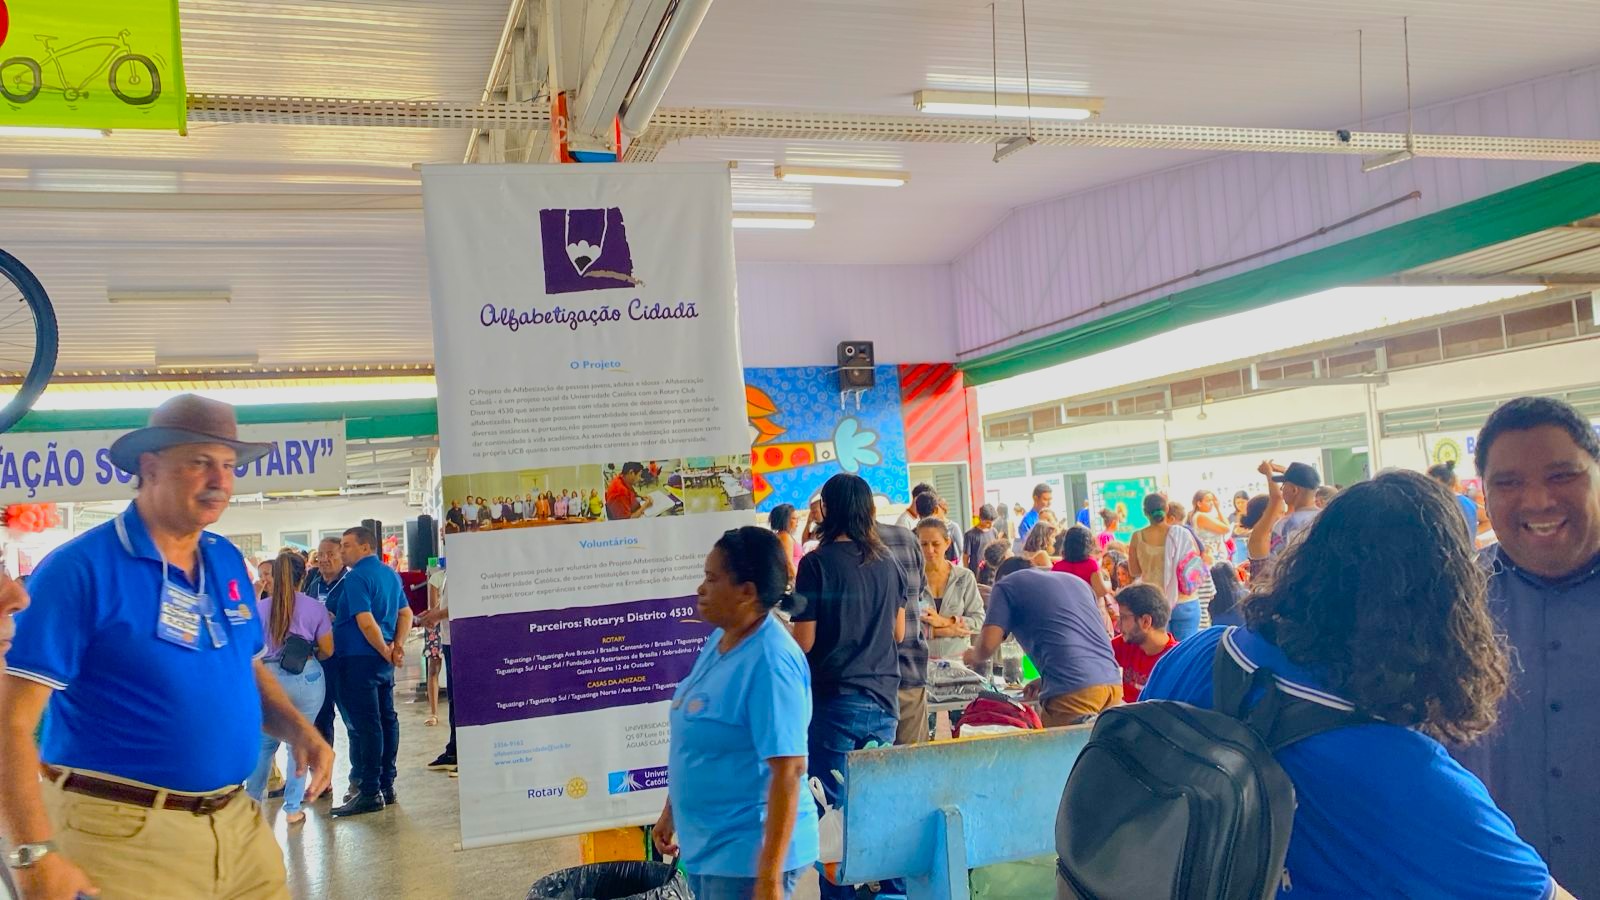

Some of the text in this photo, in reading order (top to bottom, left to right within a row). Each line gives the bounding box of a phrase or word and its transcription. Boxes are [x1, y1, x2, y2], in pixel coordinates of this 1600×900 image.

[480, 298, 699, 332] Alfabetização Cidadã
[570, 359, 621, 370] O Projeto
[579, 537, 638, 549] Voluntários
[529, 606, 693, 632] Parceiros: Rotarys Distrito 4530
[504, 656, 532, 665] Taguatinga
[536, 652, 564, 661] Taguatinga
[599, 645, 618, 653] Brasília
[619, 642, 649, 651] Centenário
[654, 639, 673, 647] Brasília
[676, 636, 703, 646] Taguatinga
[495, 666, 524, 676] Taguatinga
[565, 658, 591, 666] Fundação
[600, 654, 630, 662] Rotarianos
[638, 650, 658, 658] Brasília
[662, 646, 692, 655] Sobradinho
[630, 660, 654, 668] Outubro
[617, 676, 646, 684] AMIZADE
[496, 700, 524, 710] Taguatinga
[529, 696, 557, 706] Taguatinga
[571, 691, 598, 700] Taguatinga
[599, 688, 617, 696] Norte
[626, 740, 648, 749] ÁGUAS
[494, 756, 533, 766] www.ucb.br
[644, 770, 669, 778] Univer
[645, 778, 669, 787] Católic
[528, 785, 564, 799] Rotary
